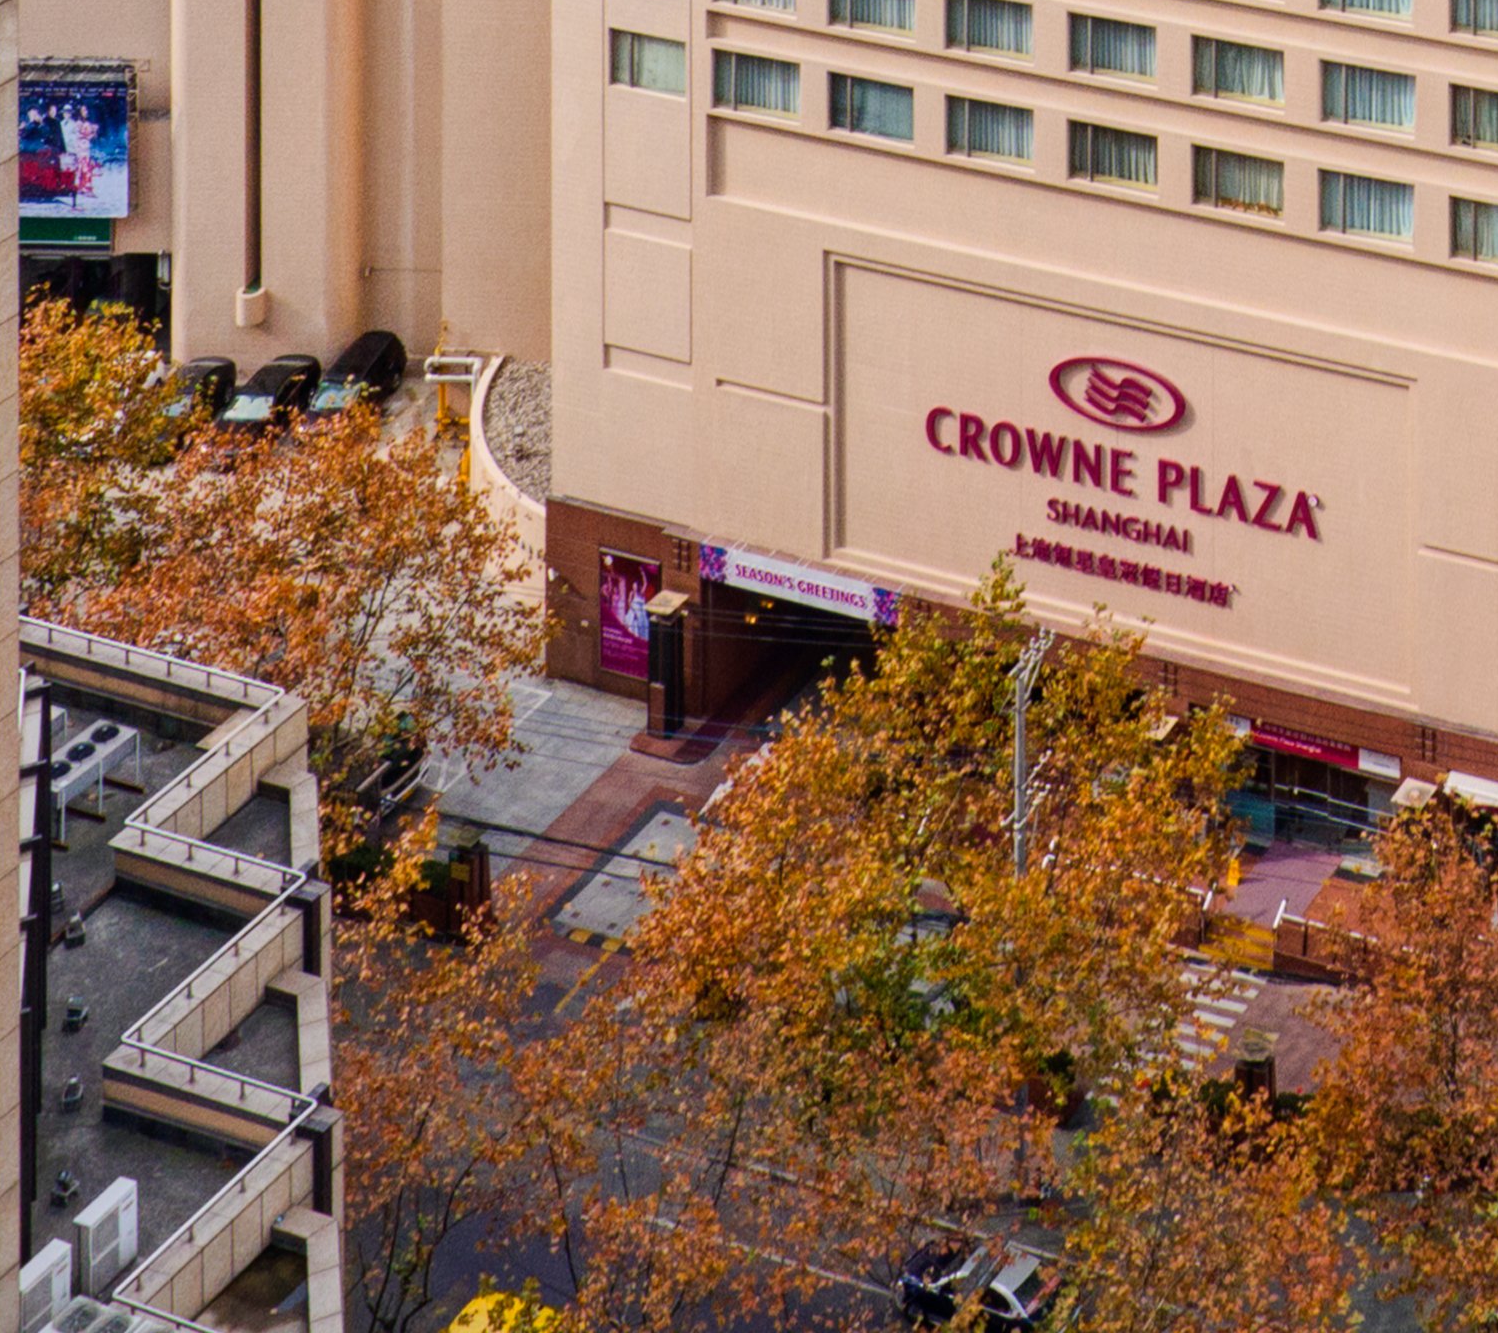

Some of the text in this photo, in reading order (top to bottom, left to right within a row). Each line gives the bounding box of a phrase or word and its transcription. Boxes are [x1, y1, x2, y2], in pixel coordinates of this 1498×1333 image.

[925, 407, 1319, 540] CROWNE PLAZA
[1046, 498, 1191, 554] SHANGHAI
[735, 563, 867, 609] SEASON'S GREETINGS
